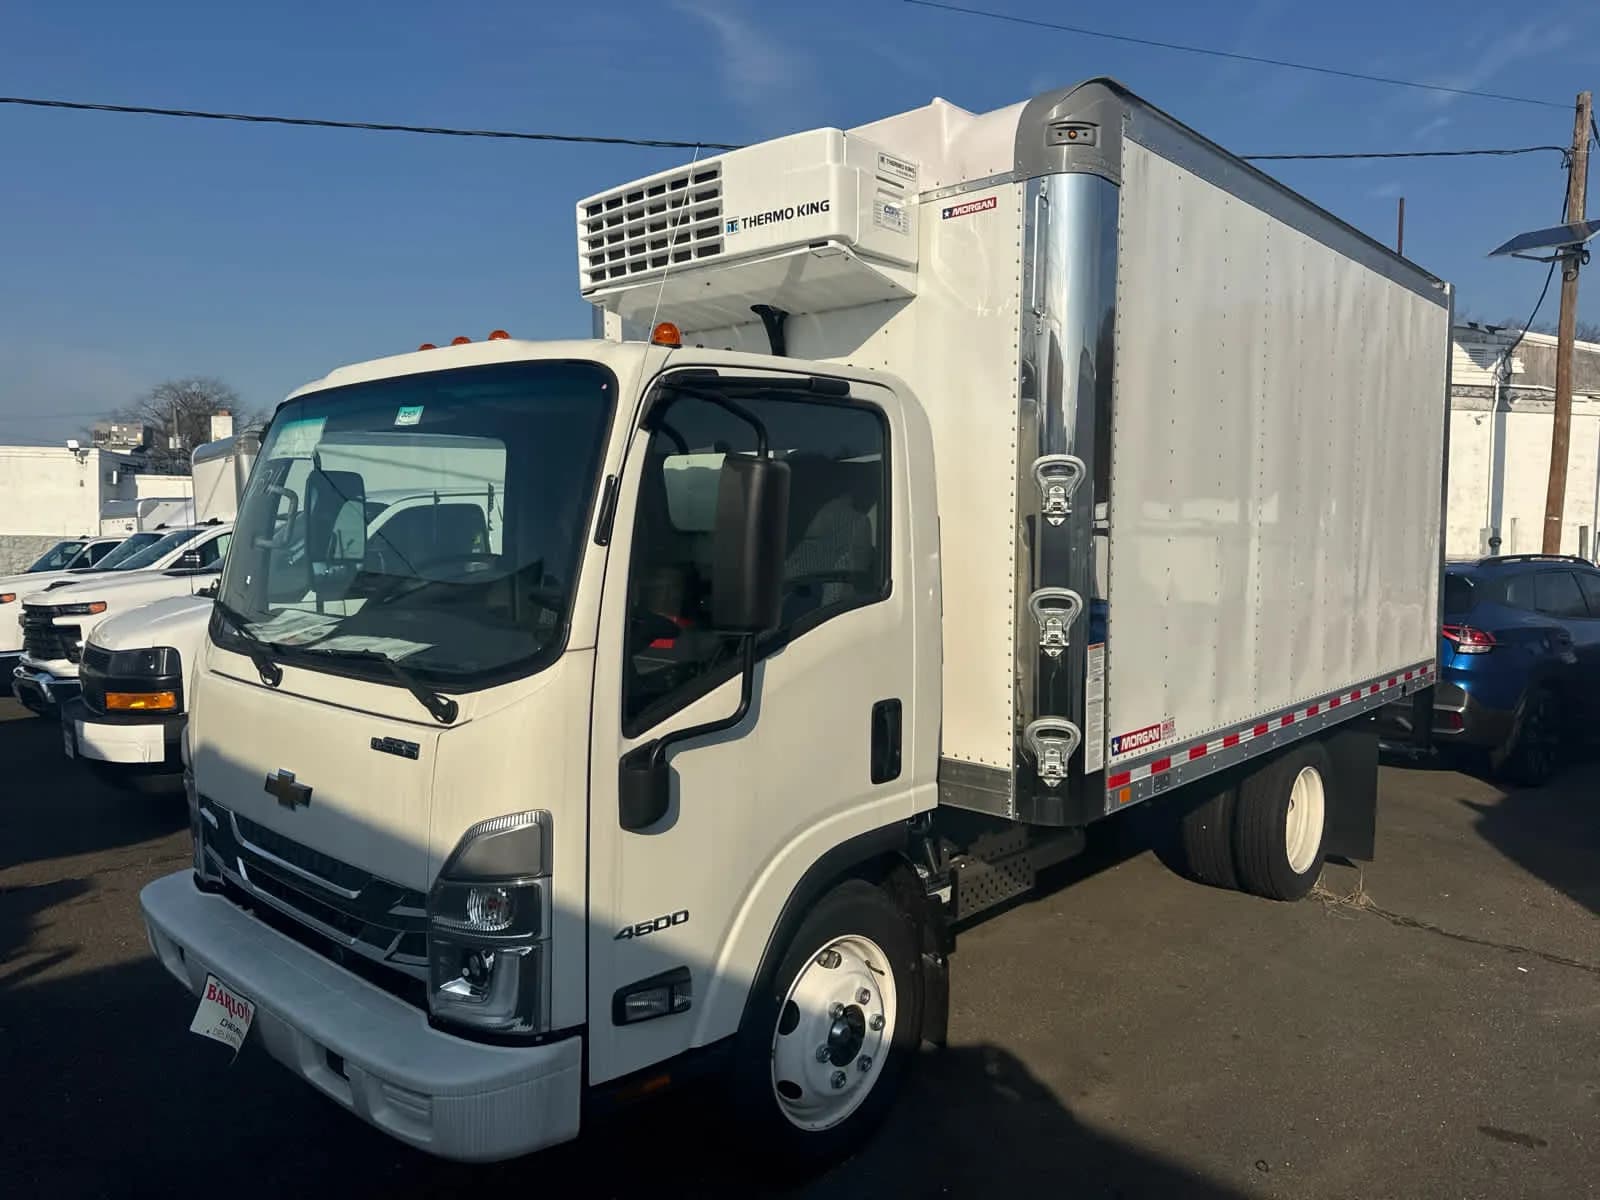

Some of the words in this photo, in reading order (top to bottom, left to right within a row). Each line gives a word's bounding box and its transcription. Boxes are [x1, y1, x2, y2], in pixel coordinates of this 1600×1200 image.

[741, 207, 794, 229] THERMO
[796, 199, 830, 217] KING
[951, 199, 995, 217] MORGAN
[1120, 727, 1160, 751] MORGAN
